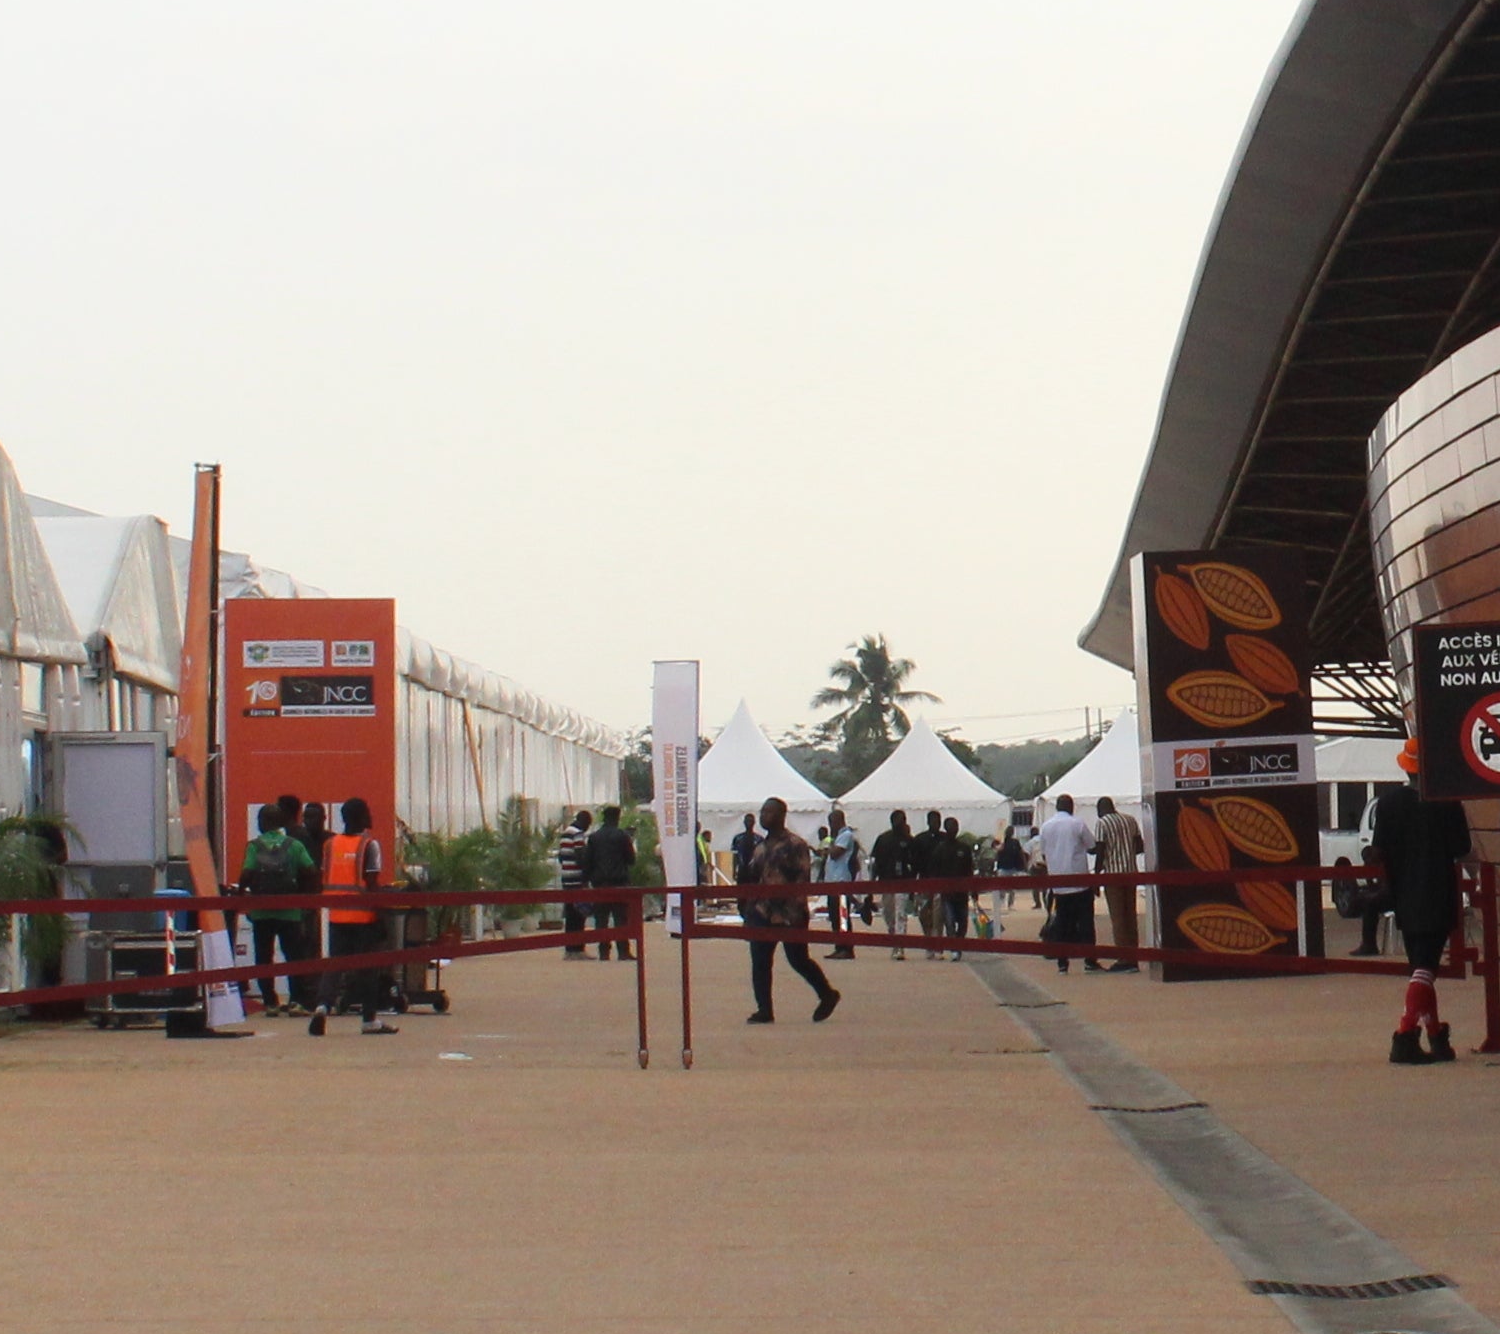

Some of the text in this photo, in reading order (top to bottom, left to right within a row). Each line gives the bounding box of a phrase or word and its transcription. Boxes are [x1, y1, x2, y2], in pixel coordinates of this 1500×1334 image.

[1438, 632, 1492, 650] ACCÈS
[1442, 654, 1475, 668] AUX
[1440, 672, 1476, 686] NON
[323, 686, 367, 705] JNCC
[1250, 754, 1292, 773] JNCC
